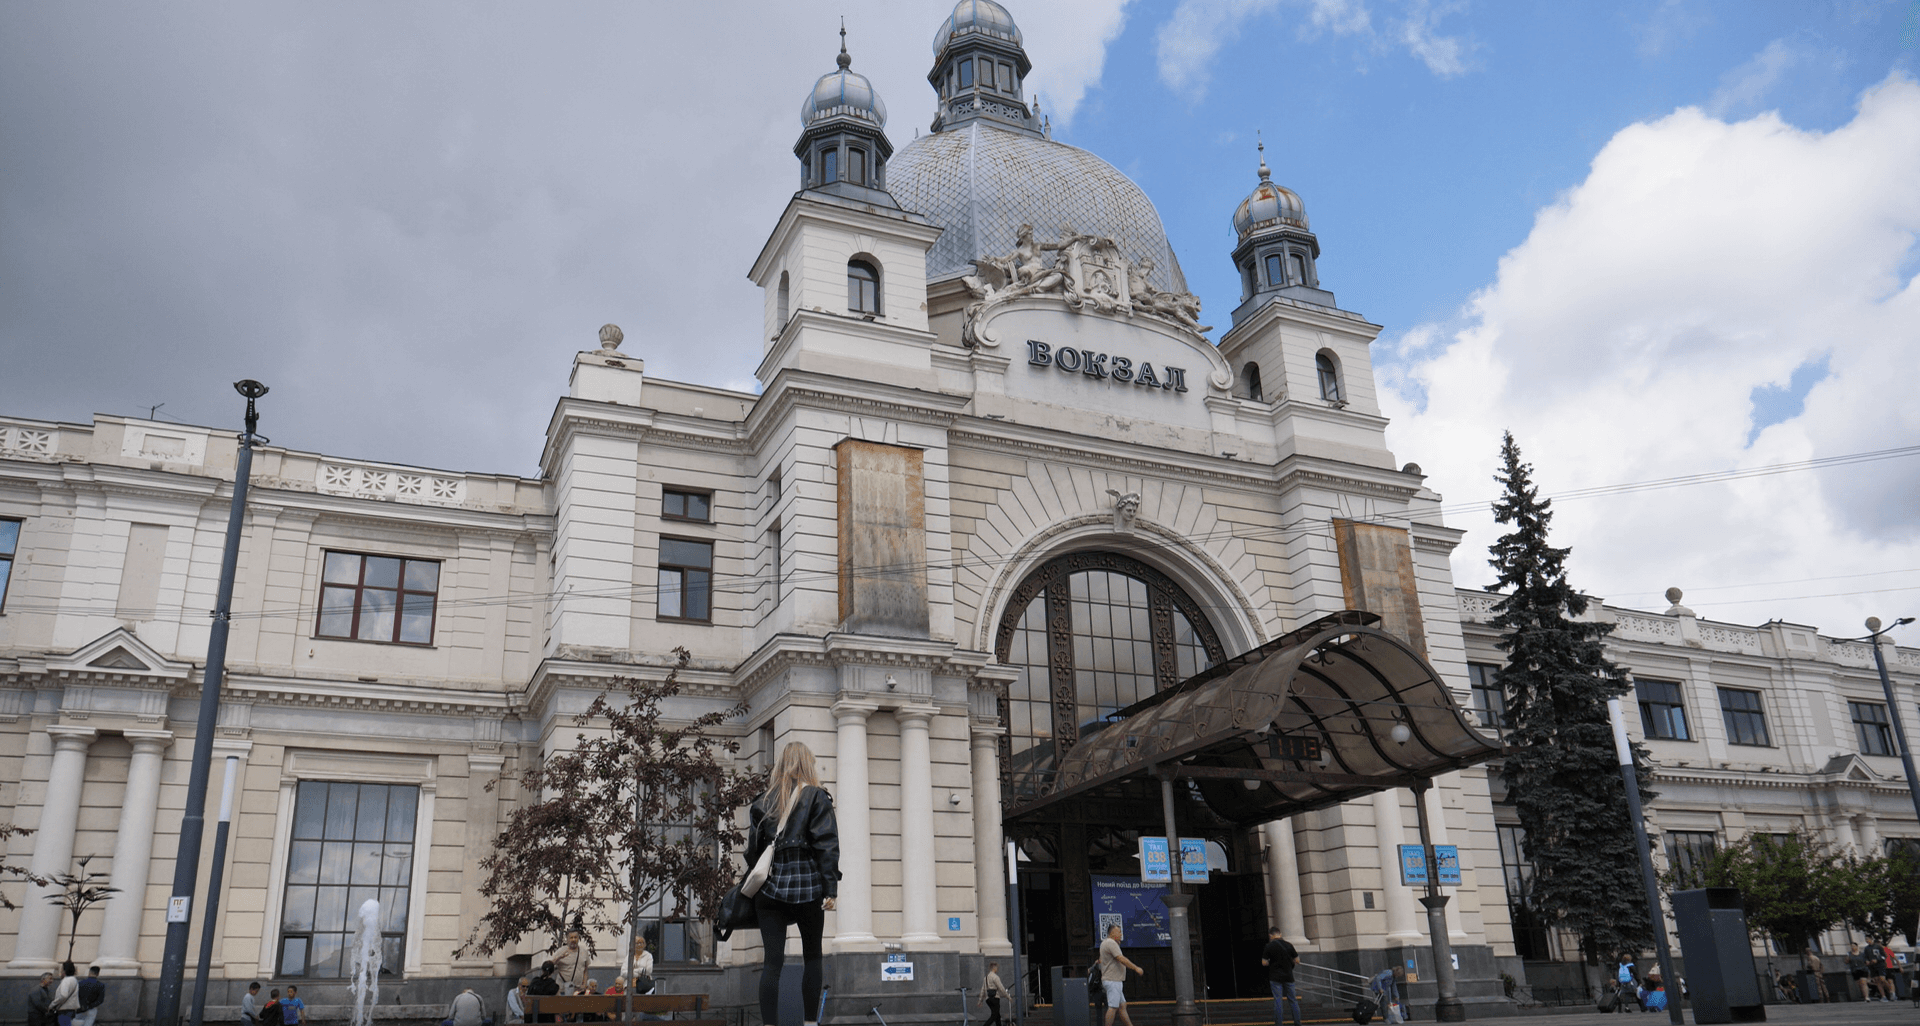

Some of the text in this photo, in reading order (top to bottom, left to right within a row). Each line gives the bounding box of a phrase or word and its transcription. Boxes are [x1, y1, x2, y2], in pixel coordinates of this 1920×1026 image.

[1027, 339, 1189, 393] ВОКЗАЛ
[1148, 851, 1166, 863] 838
[1185, 852, 1204, 864] 838
